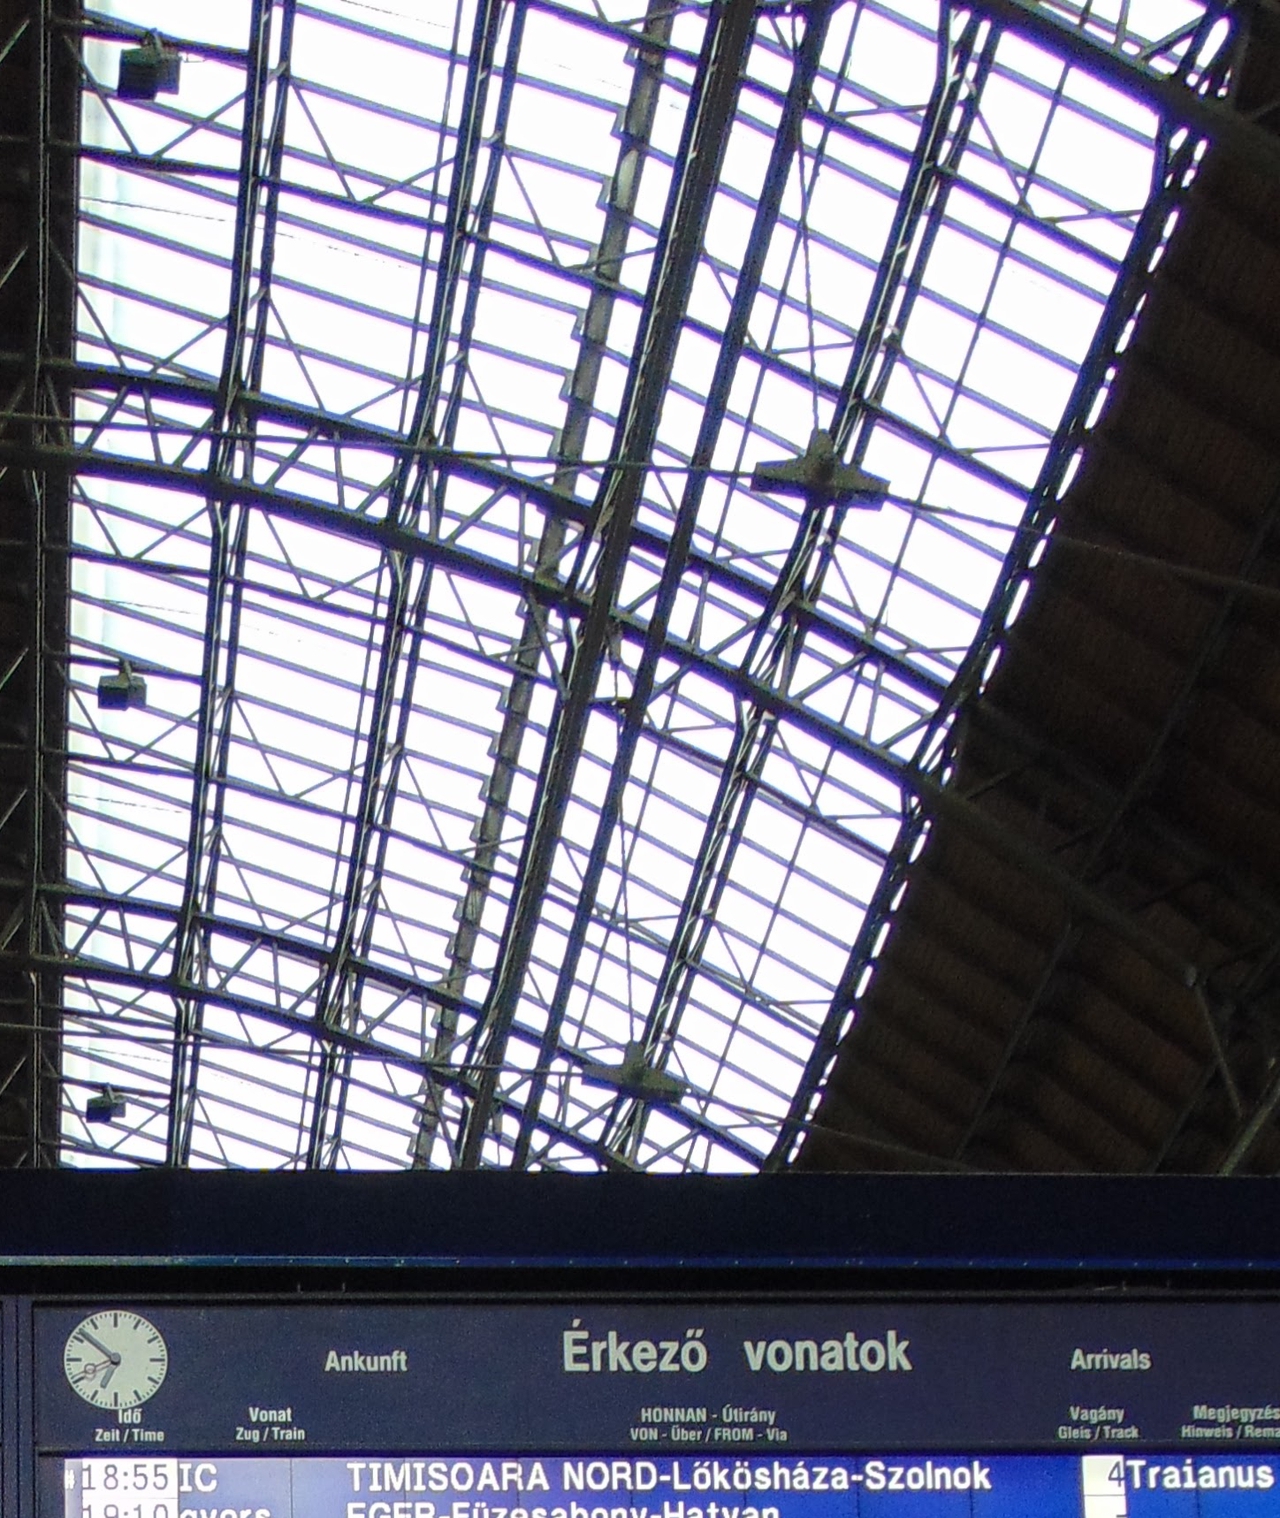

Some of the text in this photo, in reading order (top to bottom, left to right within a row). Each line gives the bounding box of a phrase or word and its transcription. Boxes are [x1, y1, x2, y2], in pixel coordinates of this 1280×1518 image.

[564, 1319, 912, 1373] Érkező vonatok
[325, 1350, 408, 1372] Ankunft
[1071, 1348, 1151, 1371] Arrivals
[118, 1408, 141, 1424] Idő
[248, 1407, 292, 1422] Vonat
[641, 1404, 775, 1426] HONNAN Útirány
[95, 1428, 165, 1442] Zeit Time
[236, 1427, 305, 1443] Zug Train
[630, 1426, 787, 1441] VON Über FROM Via
[1058, 1426, 1139, 1439] Gleis Track
[1181, 1426, 1233, 1439] Hinweis
[83, 1460, 1274, 1492] 18:55 IC TIMISOARA NORD-Lőkösháza-Szolnok Traianus
